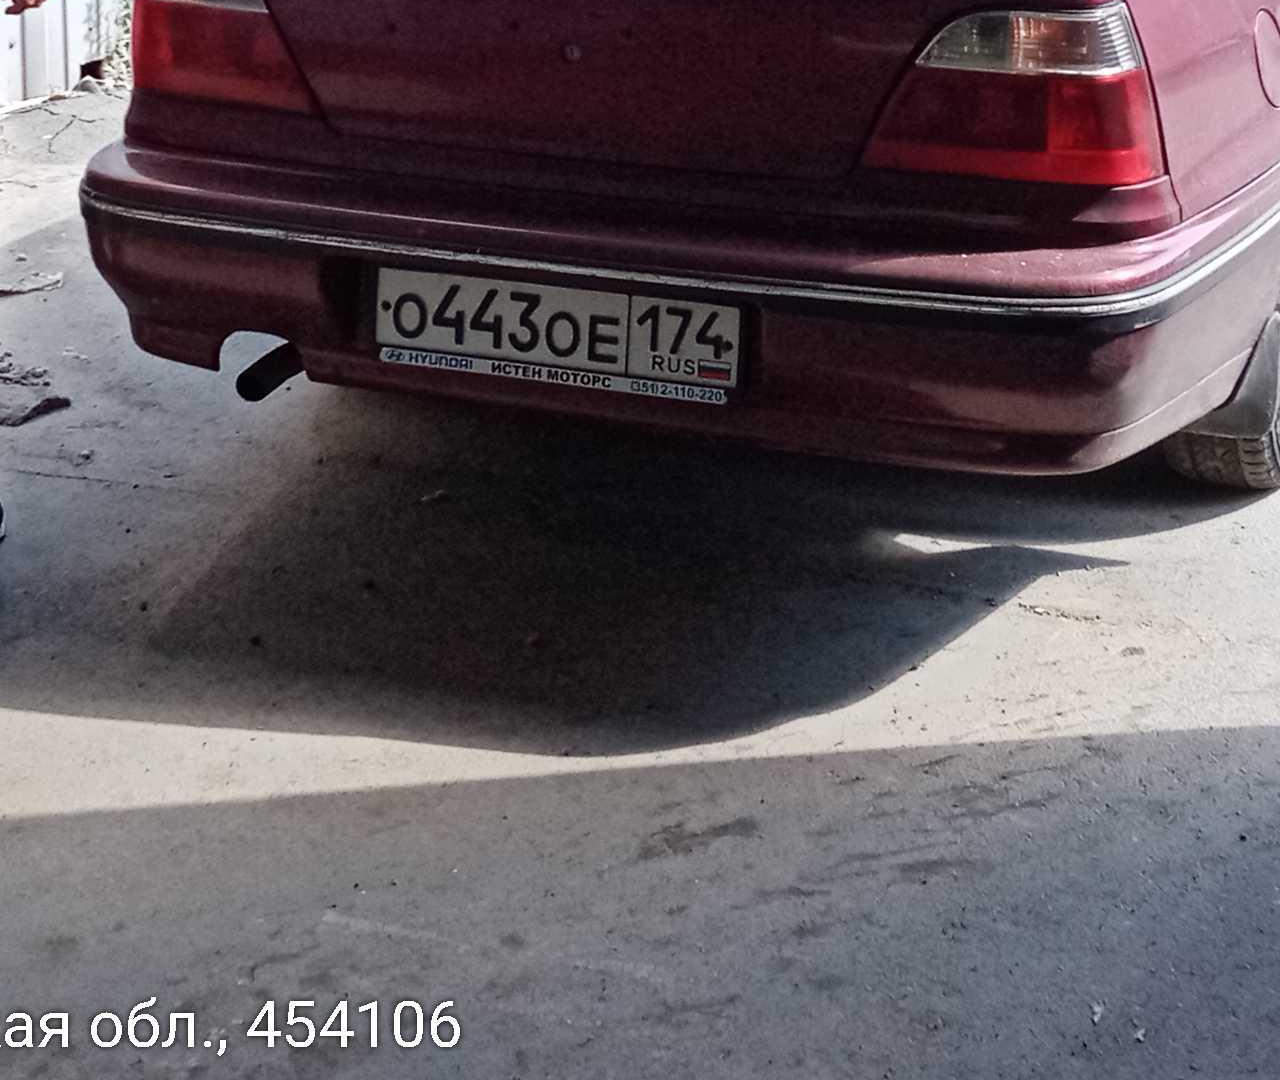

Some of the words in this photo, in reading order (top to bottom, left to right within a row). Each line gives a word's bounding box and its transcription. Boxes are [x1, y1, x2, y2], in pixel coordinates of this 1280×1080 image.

[637, 304, 724, 360] 174
[491, 362, 543, 379] ИСТЕН
[547, 369, 612, 388] МОТОРС
[652, 355, 695, 375] RUS
